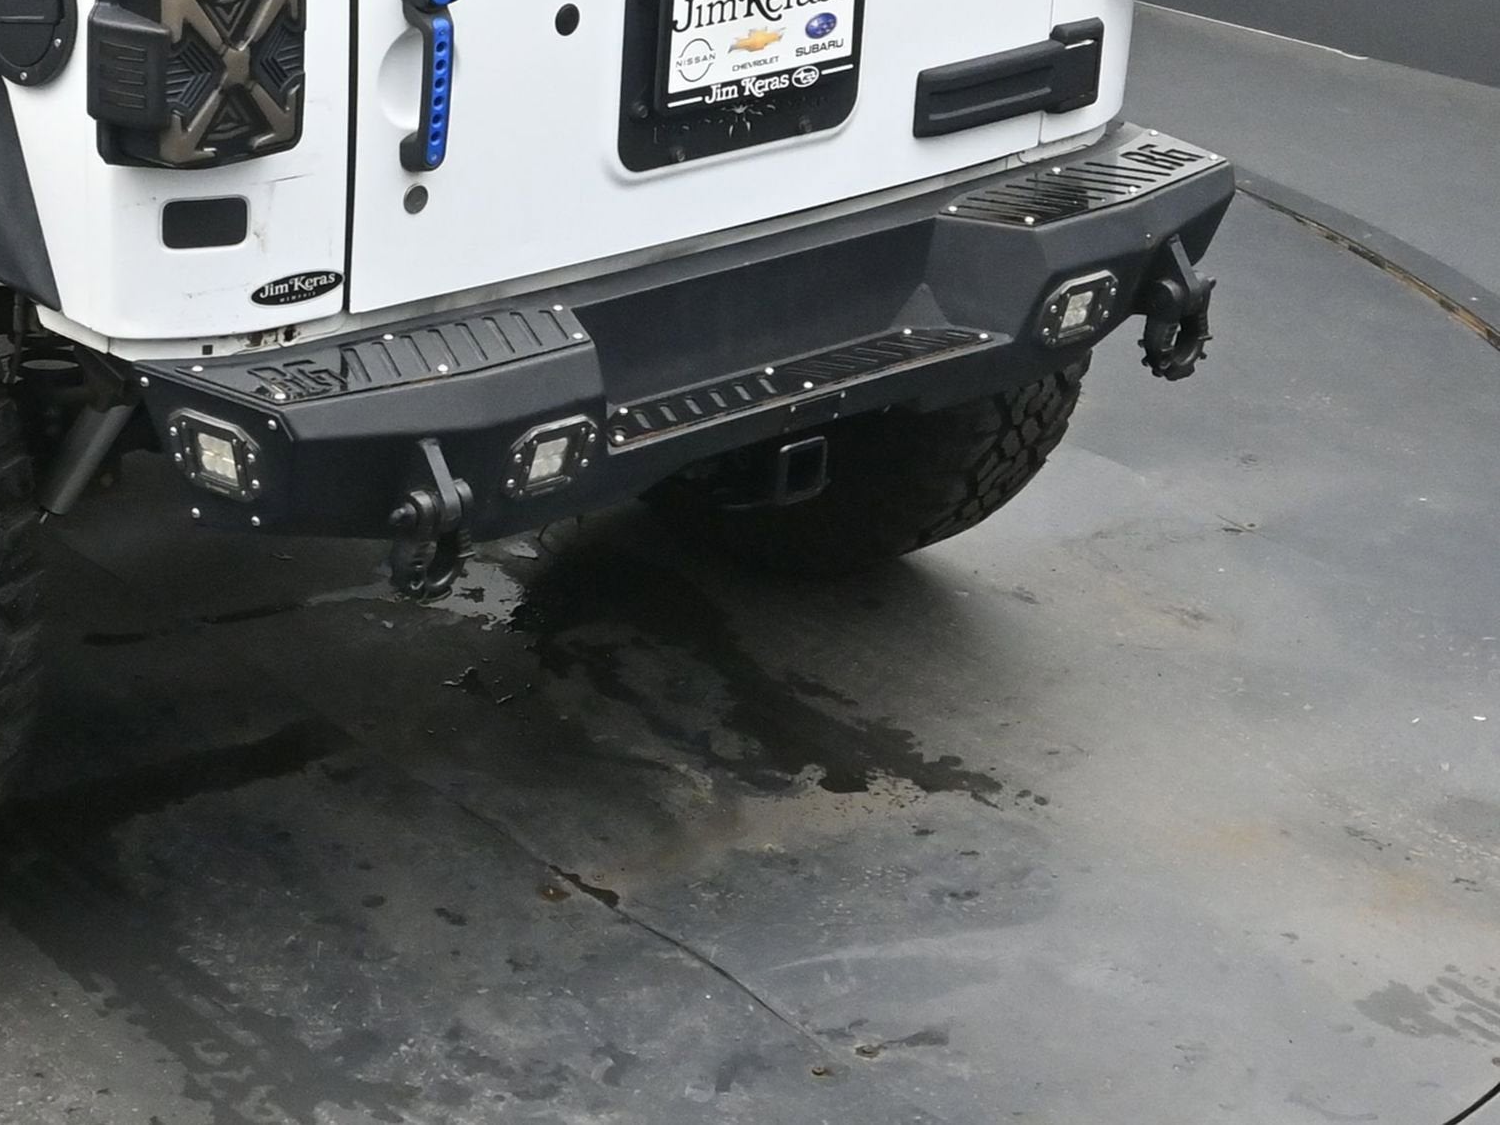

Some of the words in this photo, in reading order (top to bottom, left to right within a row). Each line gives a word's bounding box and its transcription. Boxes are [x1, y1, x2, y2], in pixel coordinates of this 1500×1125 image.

[795, 38, 844, 58] SUBARU
[675, 53, 717, 68] NISSAN
[731, 55, 780, 73] CHEVROLET
[704, 84, 739, 104] Jim
[741, 73, 791, 98] Keras
[259, 283, 289, 299] Jim
[288, 273, 337, 292] Keras
